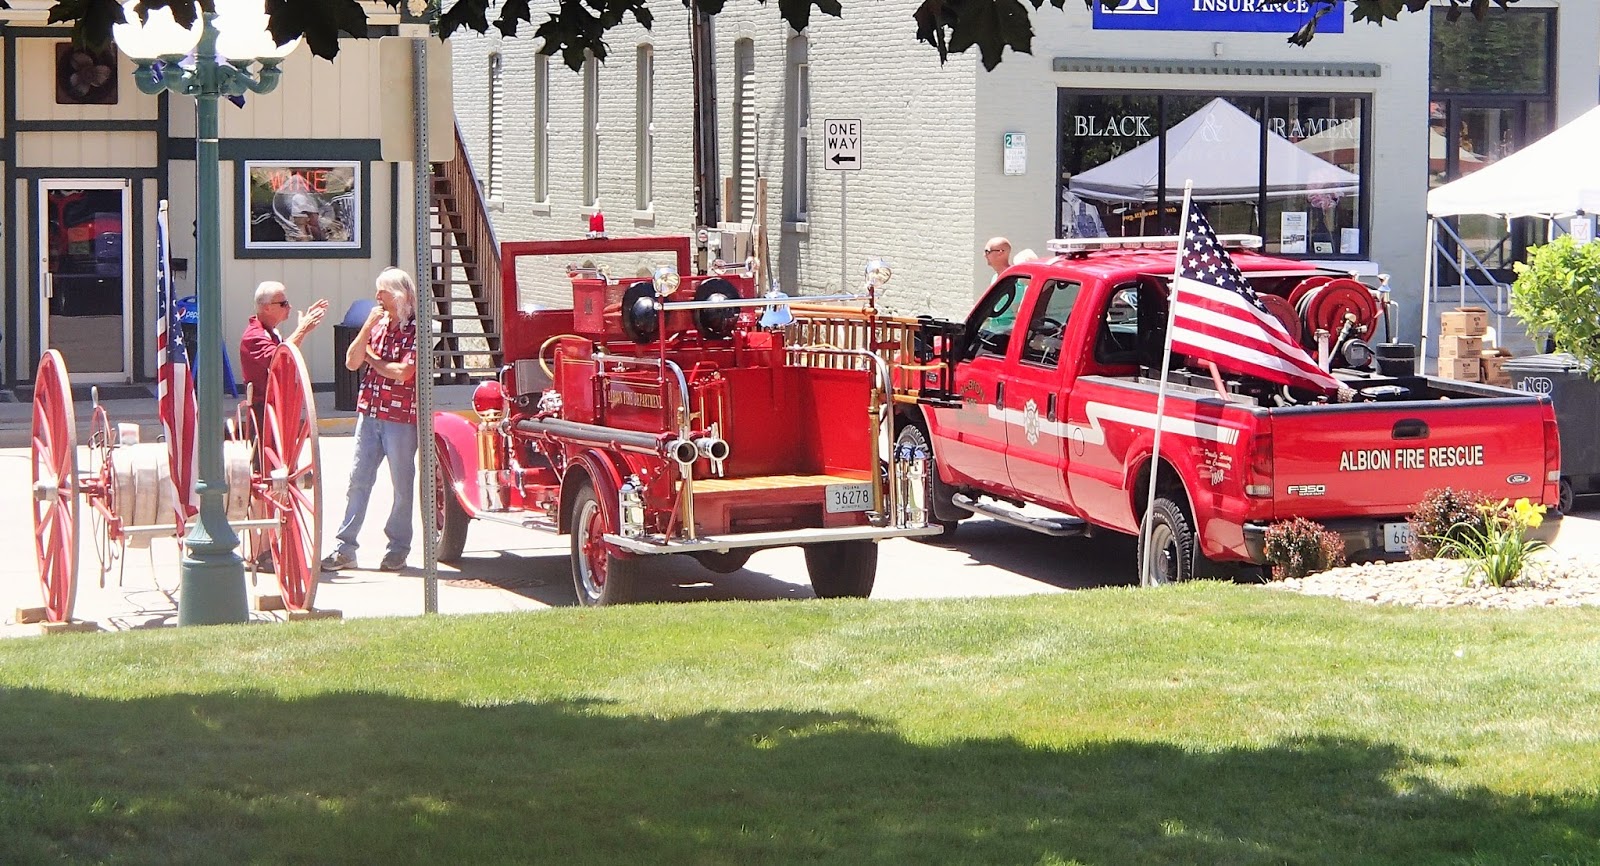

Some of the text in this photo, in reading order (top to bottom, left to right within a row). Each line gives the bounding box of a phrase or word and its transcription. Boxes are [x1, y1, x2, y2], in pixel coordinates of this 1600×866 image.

[829, 123, 857, 136] ONE
[1074, 115, 1151, 138] BLACK
[828, 138, 858, 150] WAY
[1005, 136, 1012, 147] 2
[269, 169, 329, 193] WINE
[1339, 445, 1484, 472] ALBION FIRE RESCUE
[834, 490, 869, 505] 36278
